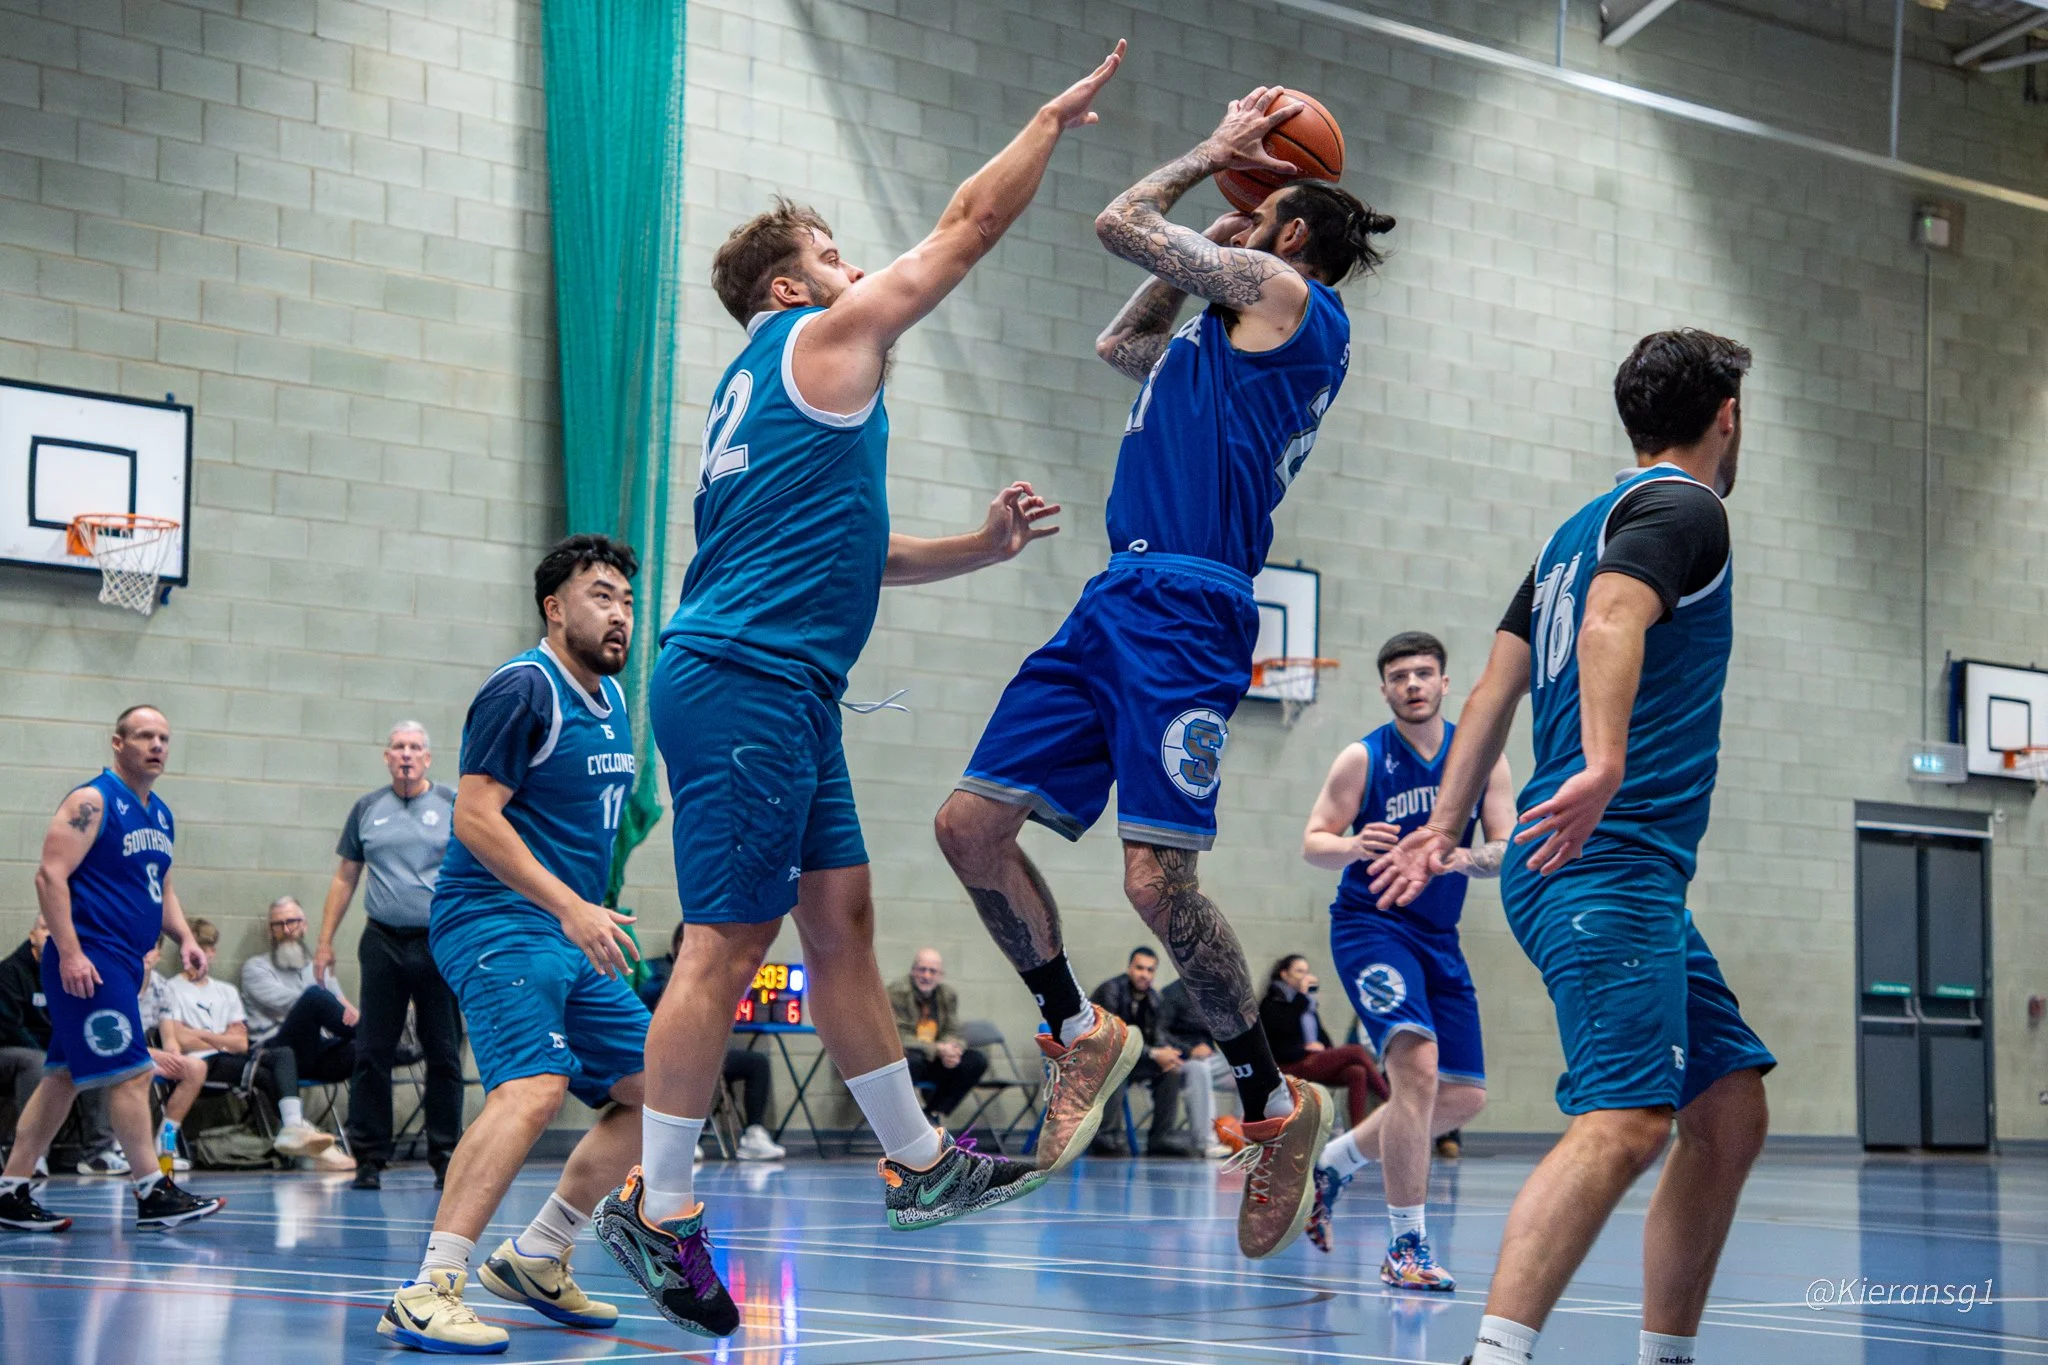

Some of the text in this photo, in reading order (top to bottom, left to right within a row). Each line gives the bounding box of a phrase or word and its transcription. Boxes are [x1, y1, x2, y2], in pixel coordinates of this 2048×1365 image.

[587, 753, 635, 775] CYCLONE
[599, 783, 625, 829] 11
[1385, 785, 1441, 823] SOUTH
[146, 862, 162, 904] 6
[787, 1000, 801, 1024] 6
